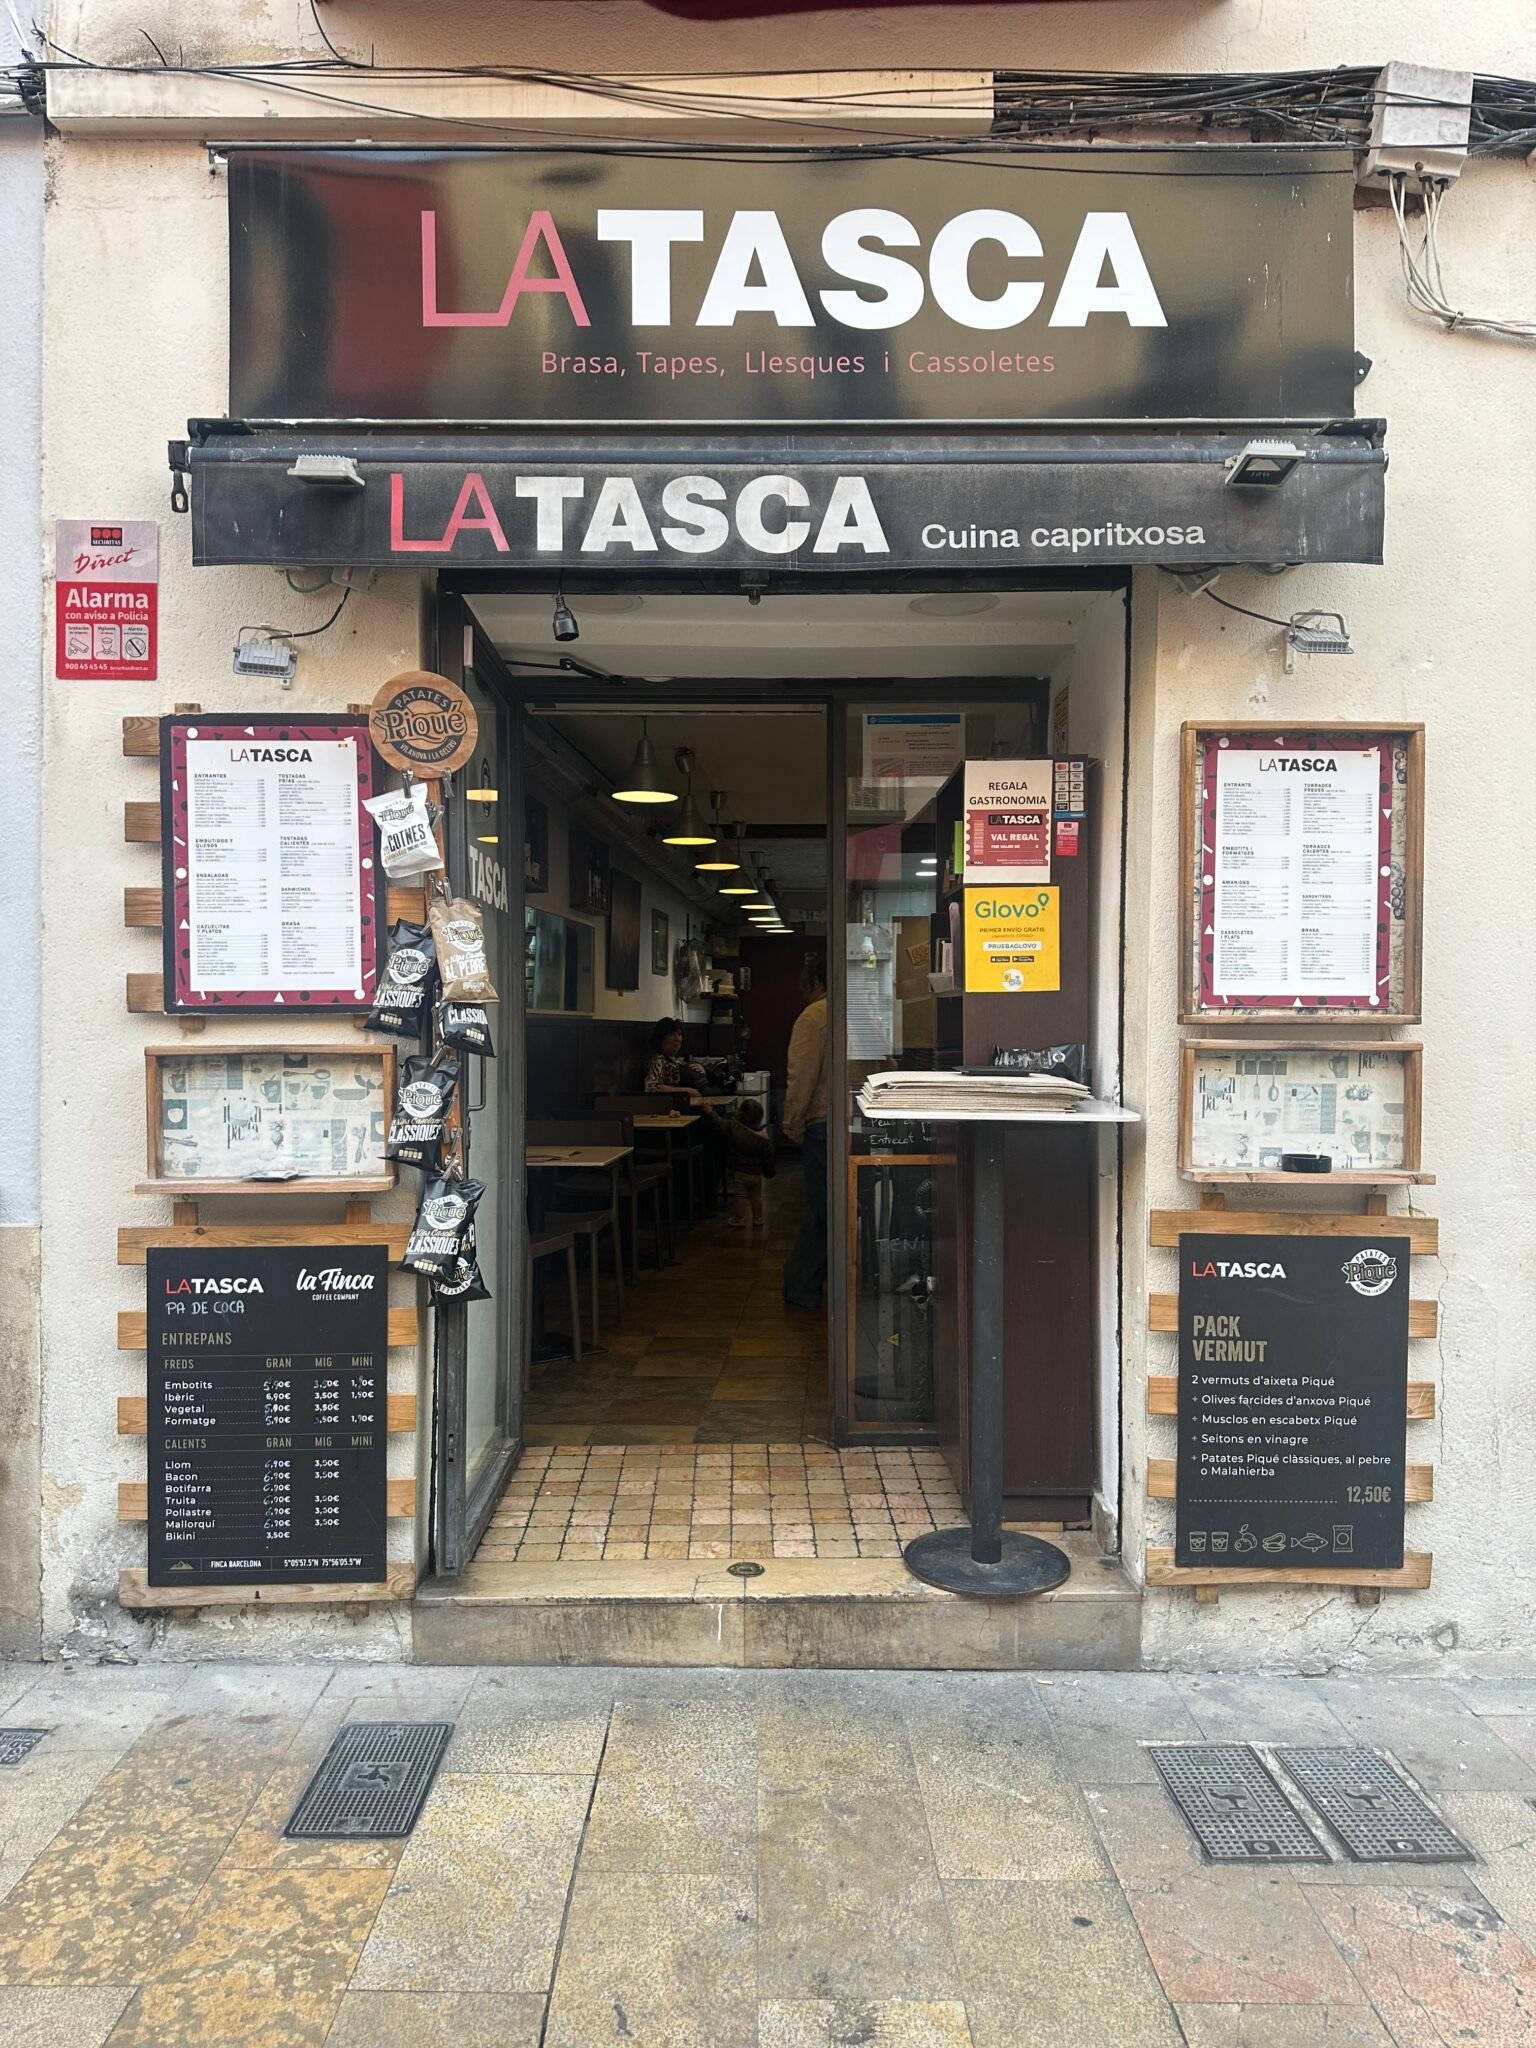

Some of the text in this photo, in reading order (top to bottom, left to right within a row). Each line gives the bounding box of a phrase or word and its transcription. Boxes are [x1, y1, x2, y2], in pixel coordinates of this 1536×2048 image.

[541, 351, 1056, 379] Brasa, Tapes, Llesques i Cassoletes
[921, 521, 1206, 555] Cuina capritxosa
[74, 547, 142, 574] Direct
[65, 587, 149, 609] Alarma
[65, 612, 81, 620] con
[83, 611, 108, 620] aviso
[395, 689, 450, 709] PATATES
[380, 701, 467, 743] Piqué
[988, 781, 1028, 791] REGALA
[969, 796, 1047, 805] GASTRONOMIA
[469, 844, 509, 913] TASCA
[975, 900, 1040, 918] Glovo
[448, 1008, 489, 1025] CLASSIQ
[387, 1124, 442, 1142] CLASSIQUES
[406, 1236, 461, 1256] CLASSIQUES
[1355, 1250, 1388, 1263] PATATES
[1344, 1257, 1397, 1284] Piqué
[312, 1293, 360, 1301] COFFEE COMPANY
[165, 1300, 246, 1316] PA DE COCA
[1192, 1315, 1241, 1338] PACK
[161, 1332, 233, 1346] ENTREPANS
[1192, 1339, 1268, 1362] VERMUT
[164, 1355, 373, 1370] FREDS GRAN MIG MINI
[164, 1380, 213, 1390] Embotits
[1191, 1375, 1336, 1390] 2 vermuts d'aixeta Piqué
[164, 1391, 195, 1402] Ibèric
[314, 1391, 340, 1400] 3,50€
[1201, 1394, 1372, 1409] Olives farcides d'anxova Piqué
[164, 1404, 205, 1415] Vegetal
[164, 1416, 216, 1428] Formatge
[1202, 1414, 1358, 1429] Musclos en escabetx Piqué
[165, 1435, 373, 1449] CALENTS GRAN MIG MINI
[1201, 1434, 1309, 1447] Seitons en vinagre
[165, 1460, 191, 1469] Llom
[1201, 1453, 1392, 1468] Patates Piqué clàssiques, al pebre
[165, 1472, 198, 1481] Bacon
[1200, 1466, 1276, 1477] o Malahierba
[165, 1484, 212, 1493] Botifarra
[1346, 1485, 1392, 1504] 12,50€
[165, 1497, 196, 1505] Truita
[165, 1508, 212, 1517] Pollastre
[165, 1520, 216, 1530] Mallorquí
[165, 1531, 291, 1540] Bikini 3,50€
[210, 1560, 228, 1568] FINCA
[228, 1559, 262, 1568] BARCELONA
